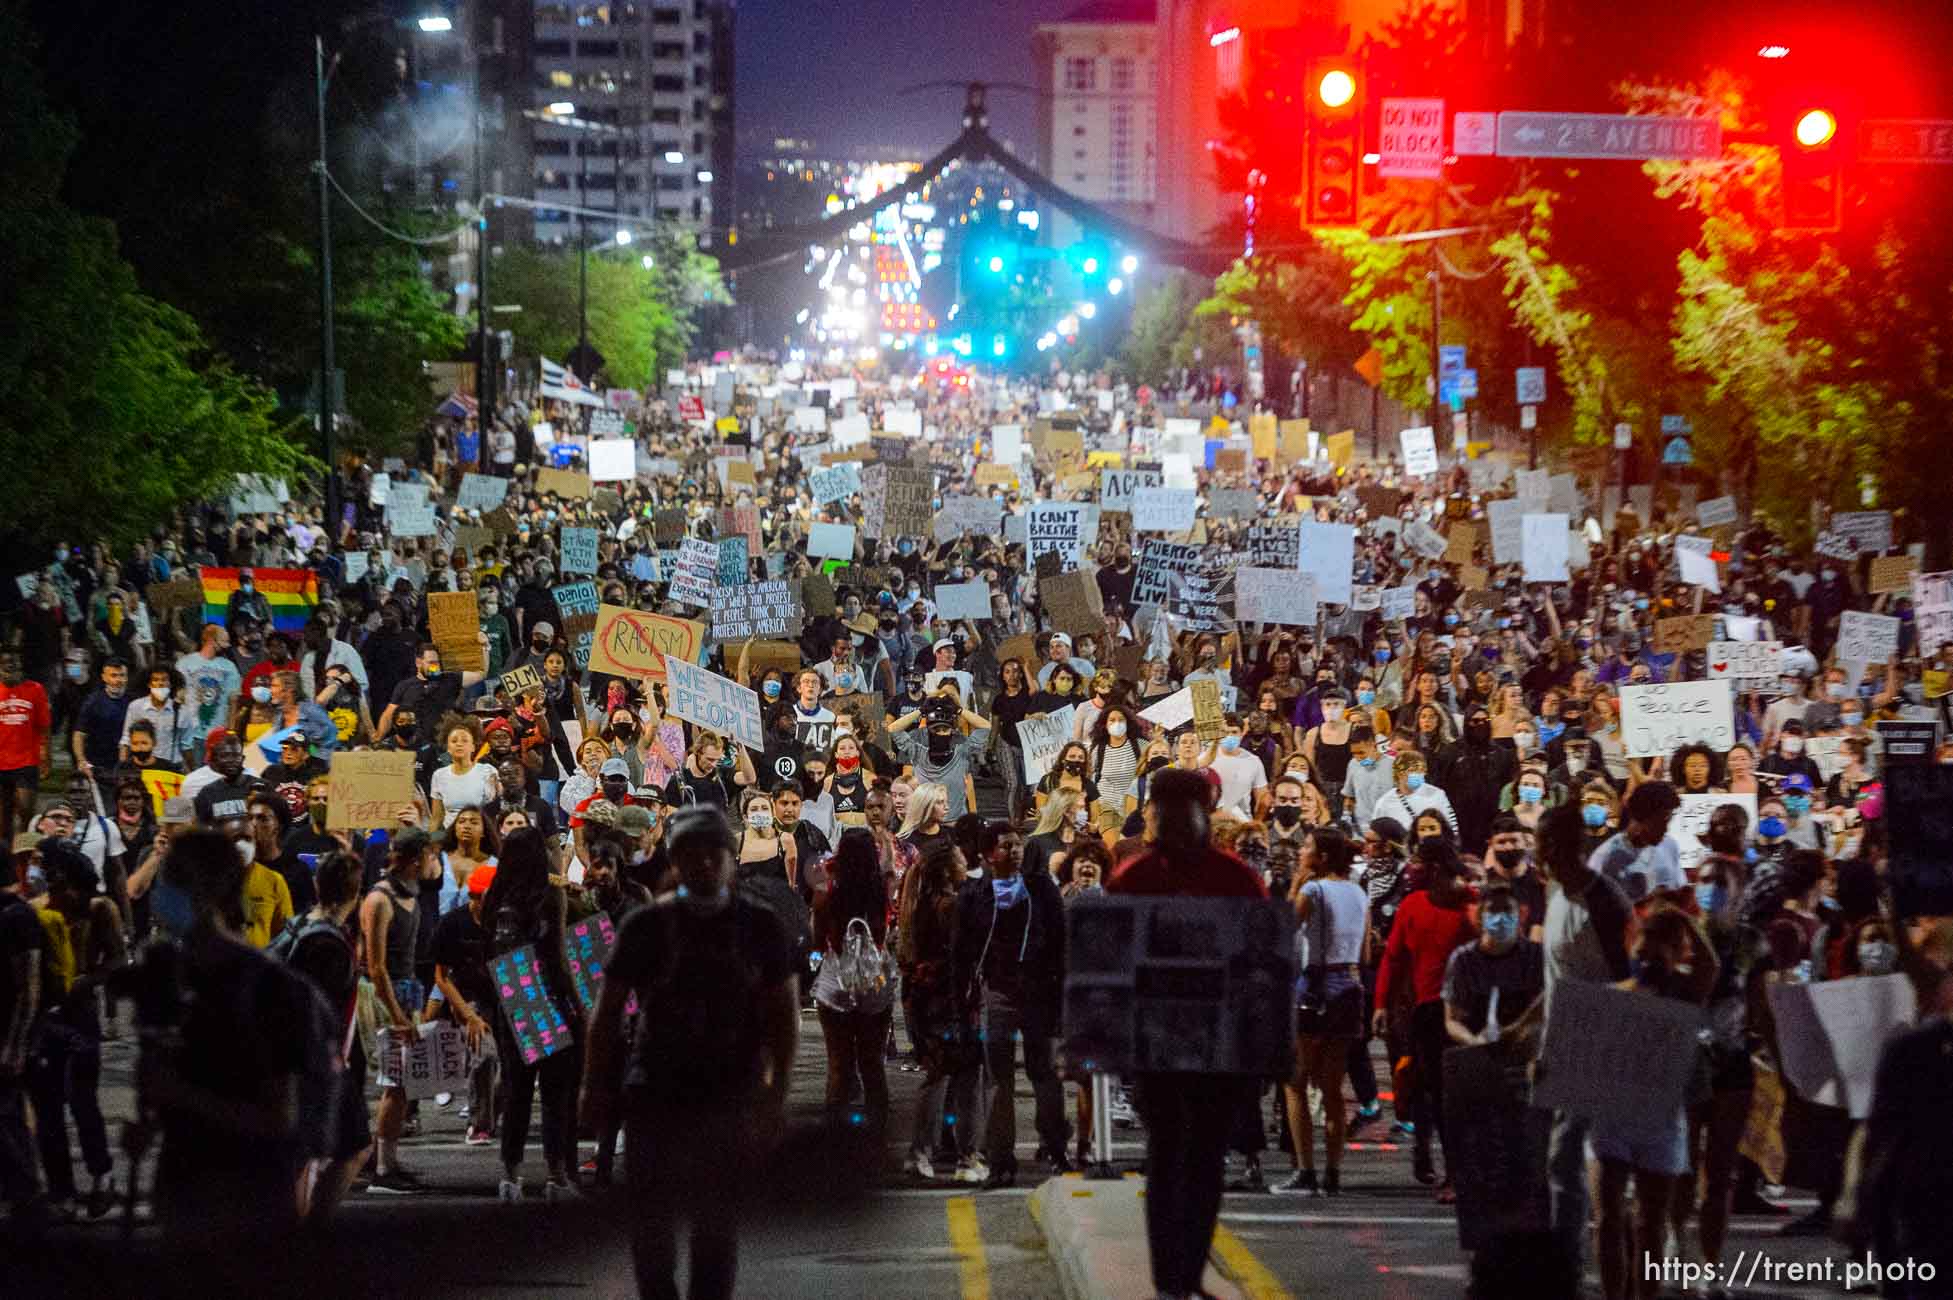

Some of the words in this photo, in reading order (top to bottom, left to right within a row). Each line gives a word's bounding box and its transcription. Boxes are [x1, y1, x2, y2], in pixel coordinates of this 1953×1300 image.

[1384, 108, 1404, 126] DO
[1412, 108, 1440, 127] NOT
[1383, 134, 1440, 153] BLOCK
[1603, 123, 1708, 151] AVENUE
[563, 536, 595, 547] STAND
[1032, 541, 1076, 550] BLACK
[1143, 539, 1198, 560] PUERTO
[564, 548, 592, 558] WITH
[570, 559, 590, 567] YOU
[558, 583, 595, 602] Denial
[737, 584, 745, 596] IS
[747, 583, 756, 594] SO
[757, 580, 788, 593] AMERICAN
[729, 596, 747, 609] WHEN
[750, 593, 763, 606] YOU
[765, 591, 792, 604] PROTEST
[723, 607, 746, 623] PEOPLE
[749, 605, 770, 620] THINK
[612, 620, 685, 657] RACISM
[712, 620, 752, 640] PROTESTING
[503, 666, 540, 695] BLM
[668, 660, 706, 692] WE
[720, 680, 760, 714] THE
[676, 687, 762, 743] PEOPLE
[780, 760, 791, 773] 13
[440, 1031, 459, 1080] BLACK
